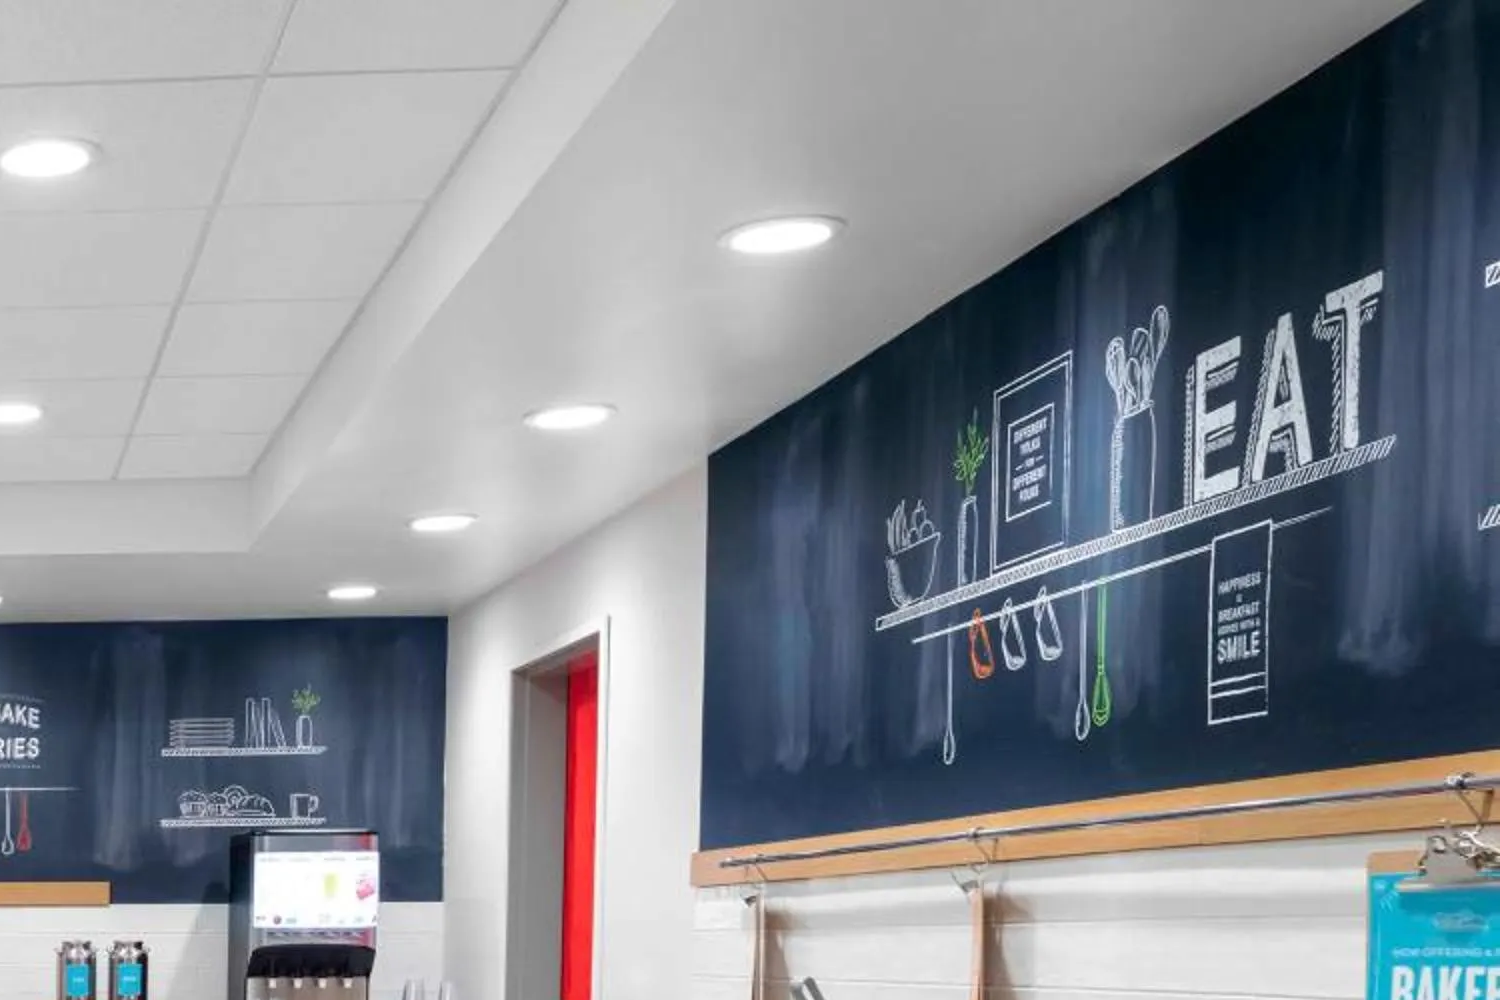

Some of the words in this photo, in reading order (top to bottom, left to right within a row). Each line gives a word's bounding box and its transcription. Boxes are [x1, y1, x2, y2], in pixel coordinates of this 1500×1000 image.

[1186, 269, 1384, 503] EAT
[1218, 571, 1261, 594] HAPPINESS
[1218, 601, 1260, 622] BREAKFAST
[1217, 630, 1260, 664] SMILE
